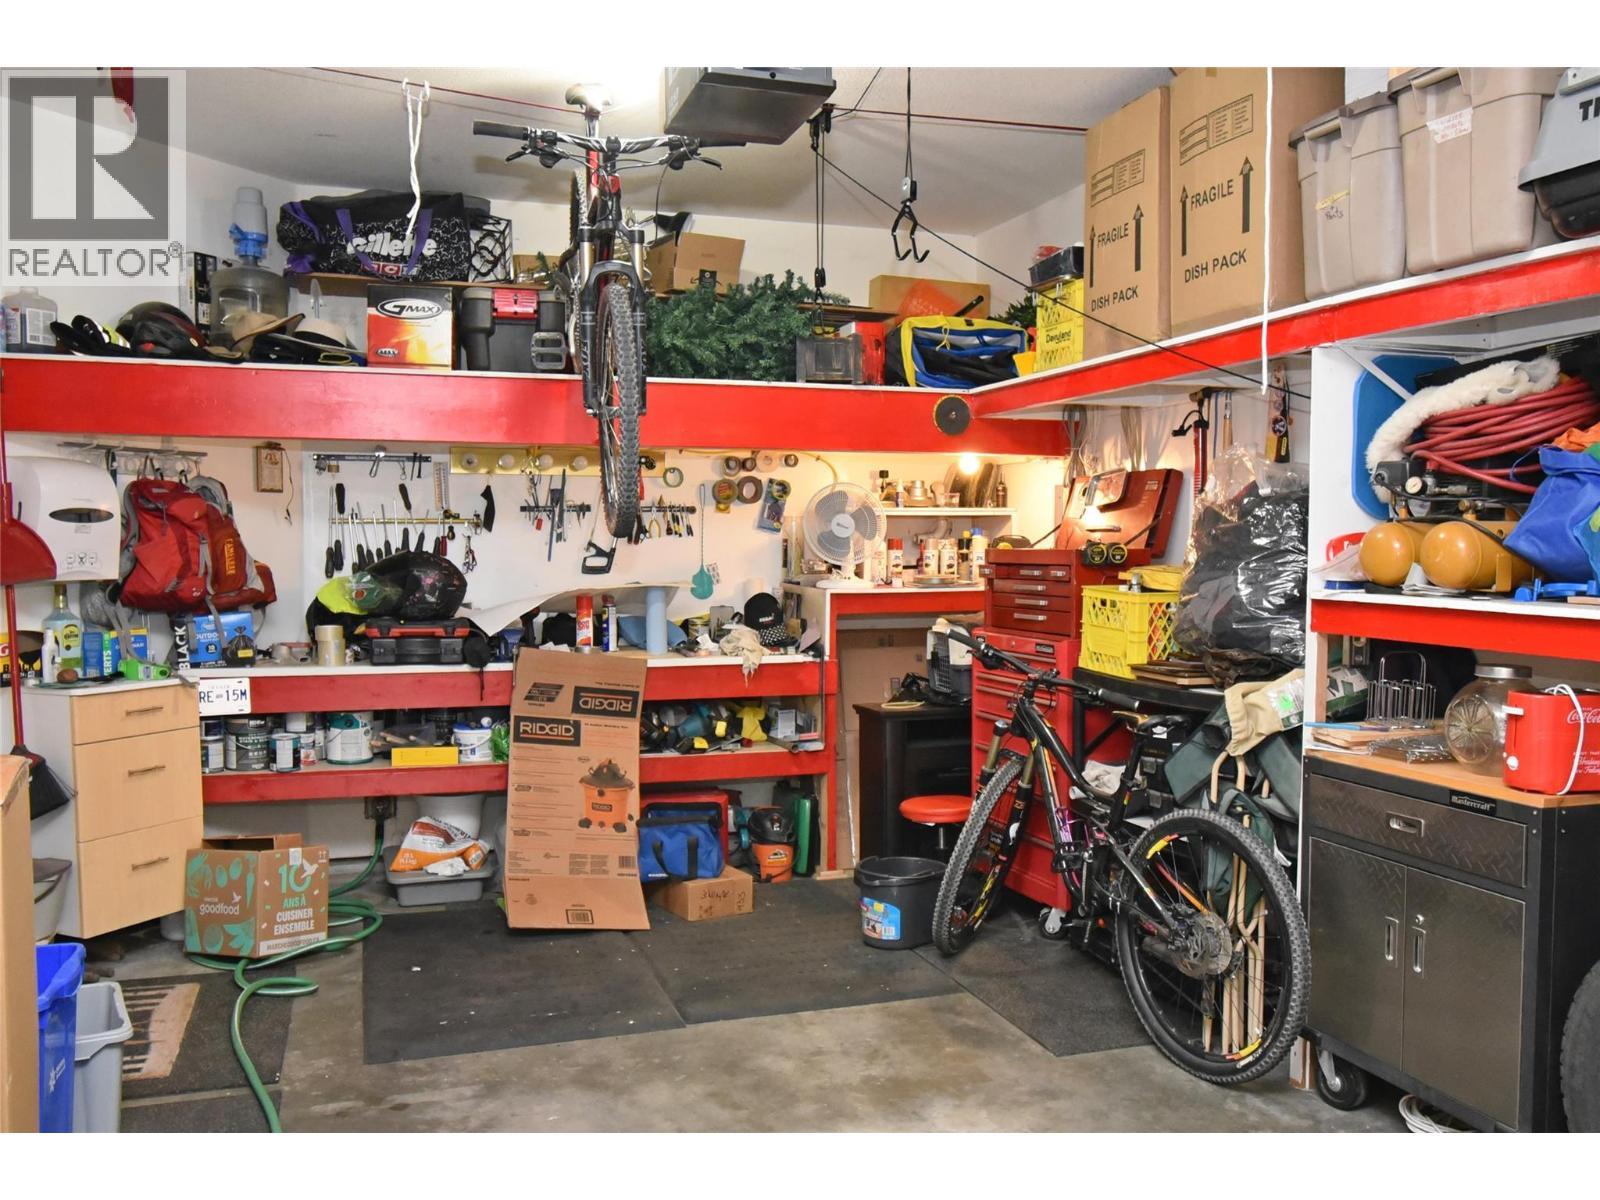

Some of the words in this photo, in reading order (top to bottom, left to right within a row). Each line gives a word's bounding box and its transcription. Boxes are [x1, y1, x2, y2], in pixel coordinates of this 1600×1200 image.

[1190, 179, 1234, 211] FRAGILE
[346, 232, 437, 257] Gillete
[1097, 222, 1129, 248] FRAGILE
[1184, 260, 1208, 283] DISH
[1212, 248, 1247, 274] PACK
[1091, 293, 1110, 312] DISH
[1112, 285, 1139, 306] PACK
[195, 631, 227, 641] OUTDOR
[174, 625, 191, 670] BLACK
[579, 697, 633, 712] RIDGID
[519, 721, 575, 737] RIDGID
[199, 902, 240, 915] goodfood
[276, 907, 313, 922] CUISINER
[273, 920, 315, 935] ENSEMBLE
